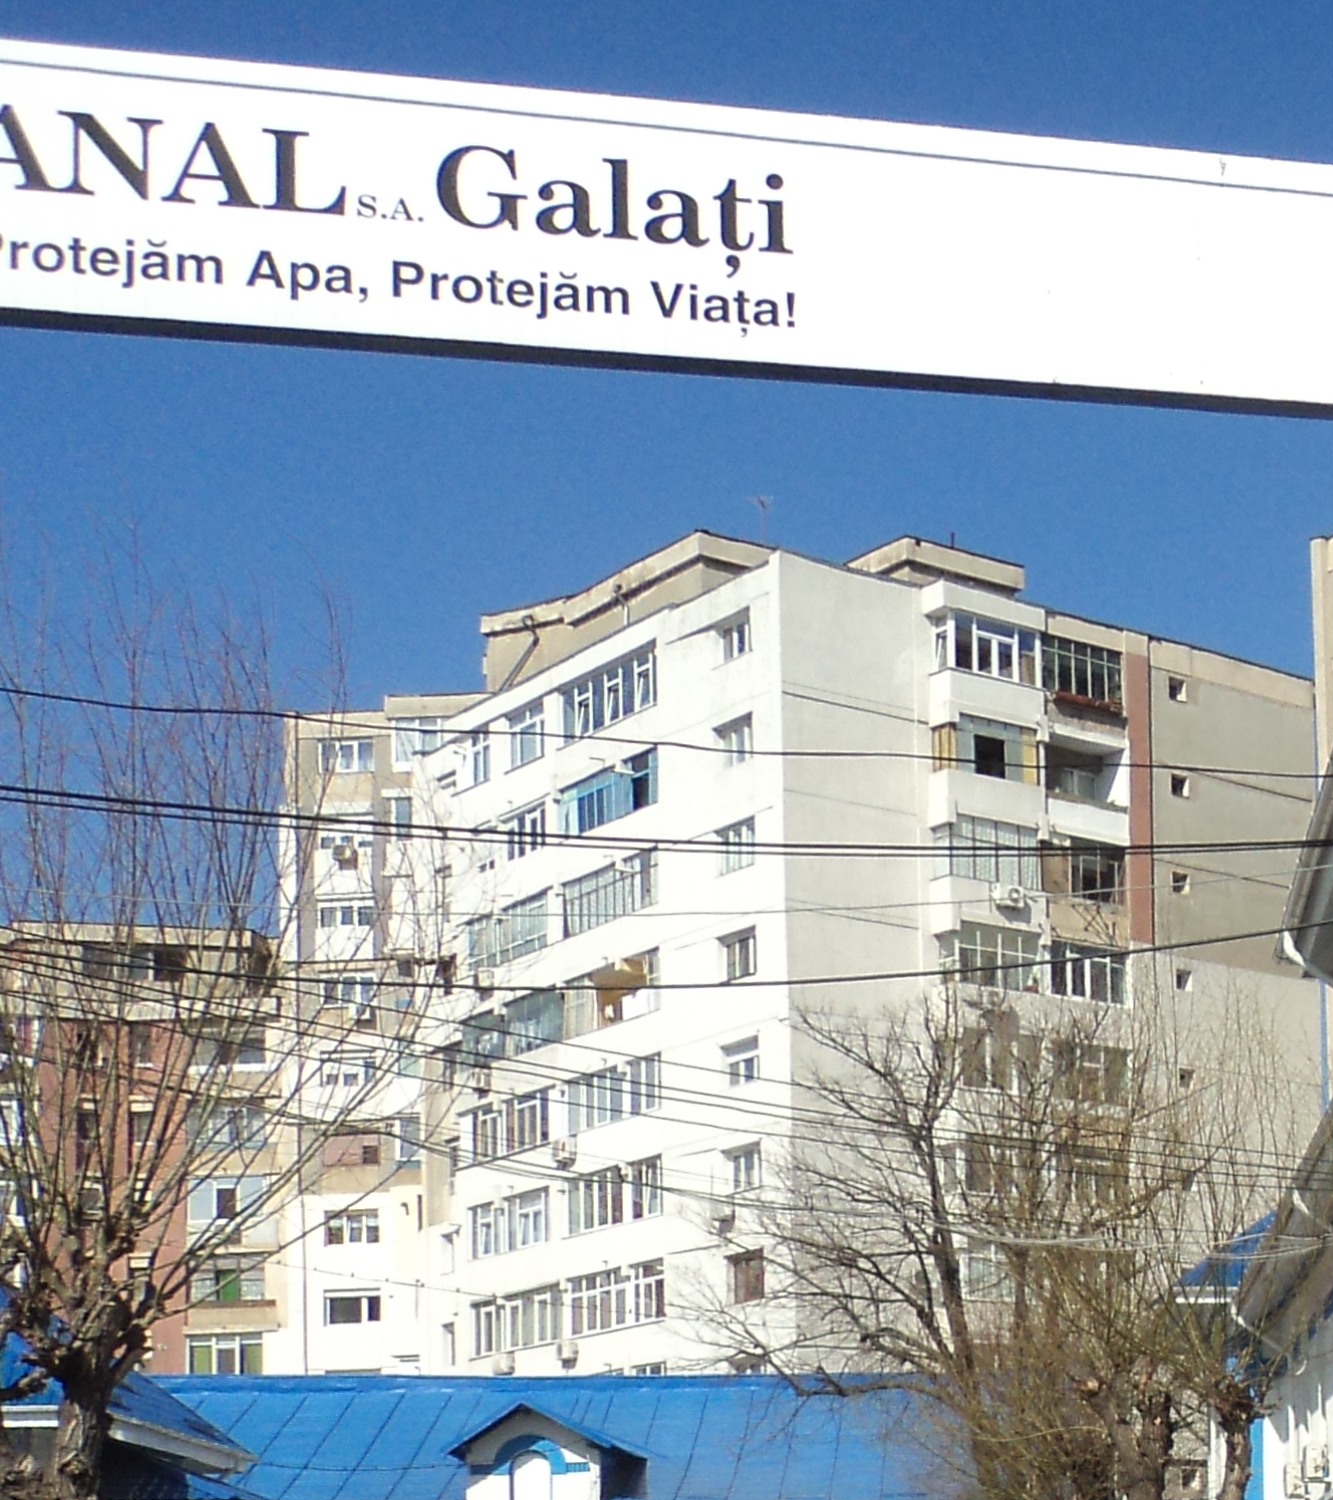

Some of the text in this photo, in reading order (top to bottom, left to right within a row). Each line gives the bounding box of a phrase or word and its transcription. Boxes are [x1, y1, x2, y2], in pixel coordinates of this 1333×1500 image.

[356, 193, 424, 222] S.A.
[435, 144, 794, 278] Galați
[0, 237, 796, 338] rotejăm Apa, Protejăm Viața!
